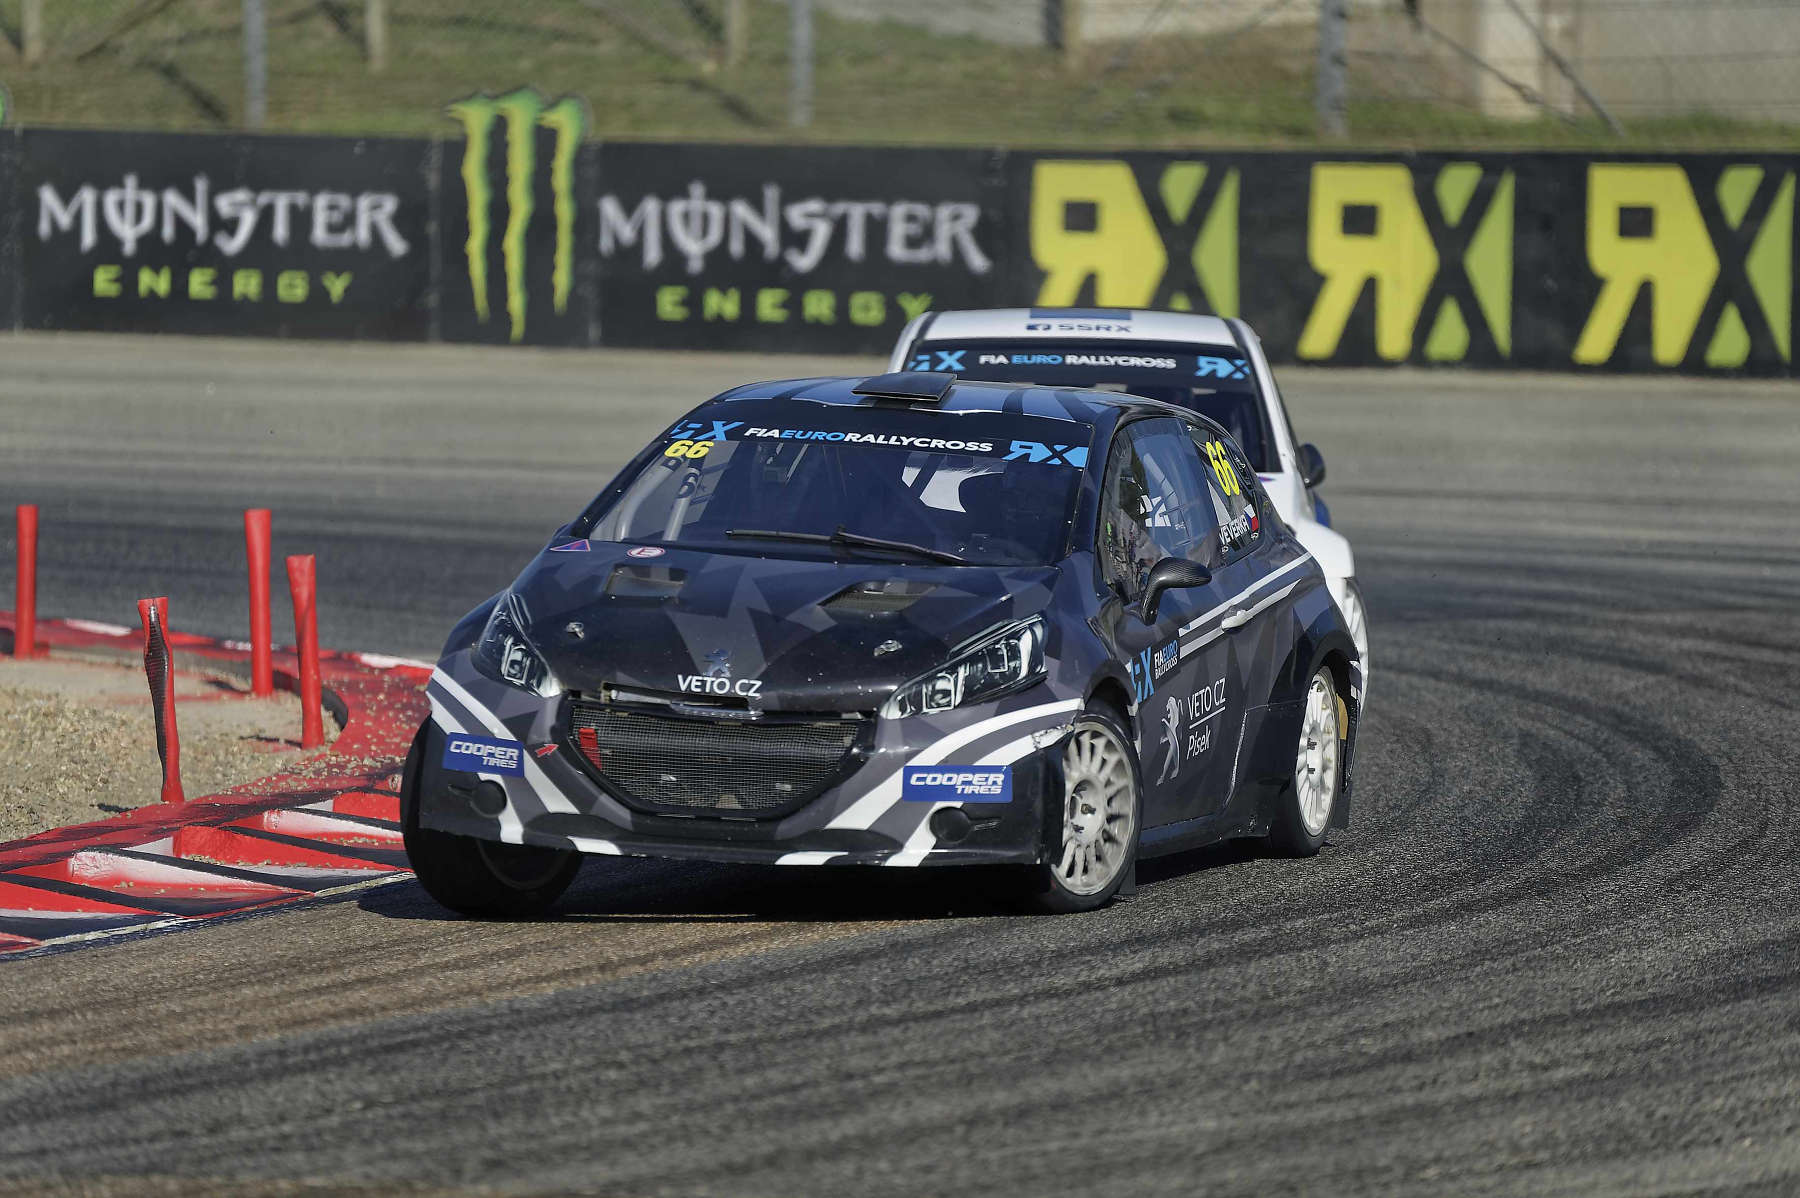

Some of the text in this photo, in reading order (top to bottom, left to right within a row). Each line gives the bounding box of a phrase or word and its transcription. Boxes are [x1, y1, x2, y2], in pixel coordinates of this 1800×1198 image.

[38, 172, 409, 258] MONSTER
[598, 180, 992, 274] MONSTER
[93, 264, 354, 303] ENERGY
[656, 285, 934, 327] ENERGY
[1058, 323, 1131, 332] SSRX
[979, 354, 1177, 369] FIA EURO RALLYCROSS
[664, 440, 715, 459] 66
[1205, 440, 1240, 496] 66
[677, 674, 762, 697] VETO.CZ
[450, 741, 519, 761] COOPER
[482, 757, 518, 769] TIRES
[910, 773, 1004, 785] COOPER
[955, 785, 1002, 794] TIRES
